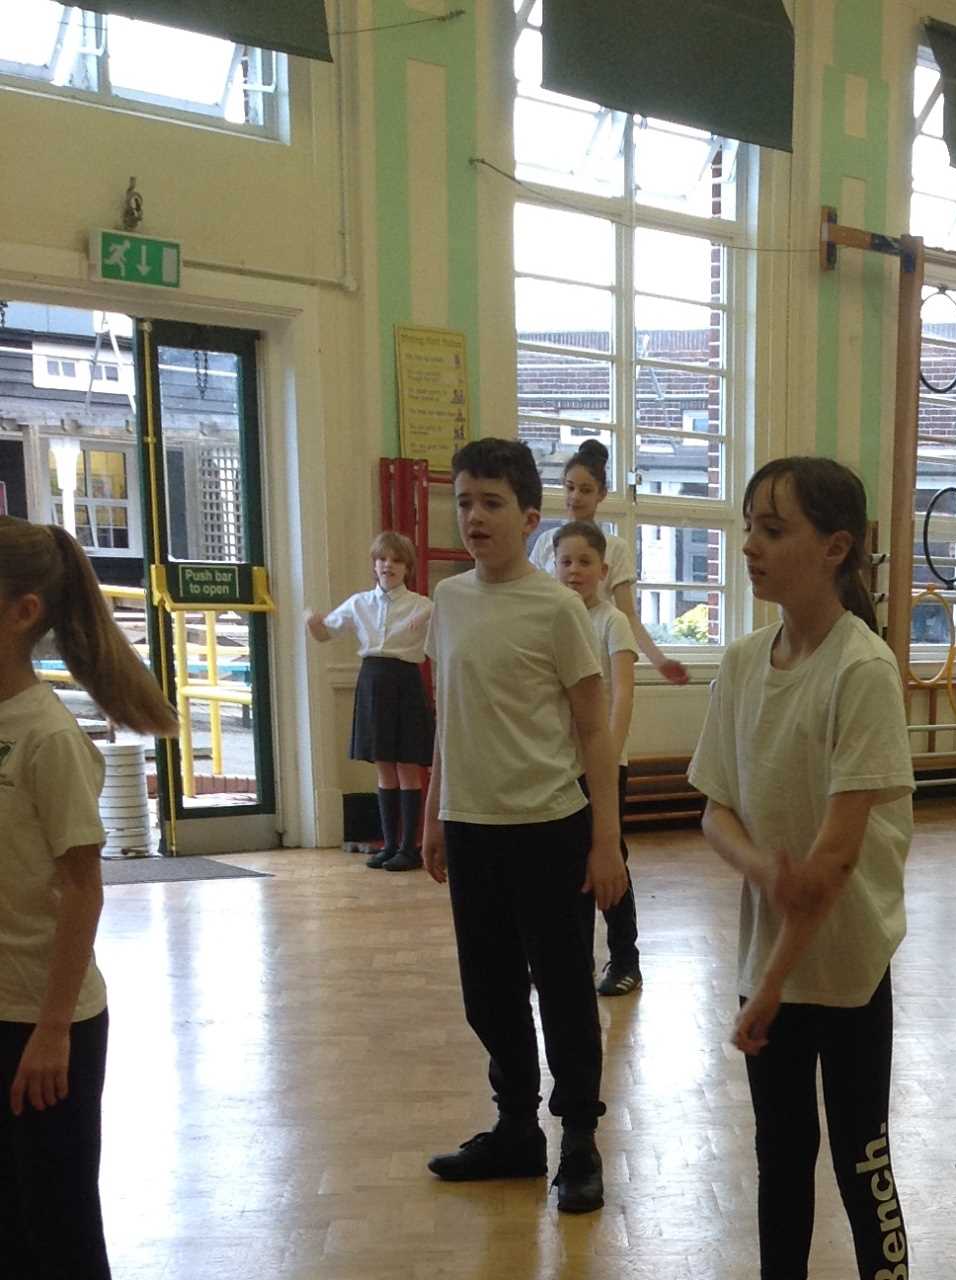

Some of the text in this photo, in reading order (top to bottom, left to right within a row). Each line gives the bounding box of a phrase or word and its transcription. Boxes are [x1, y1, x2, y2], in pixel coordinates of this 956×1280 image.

[184, 568, 232, 582] Push bar
[189, 583, 229, 596] to open
